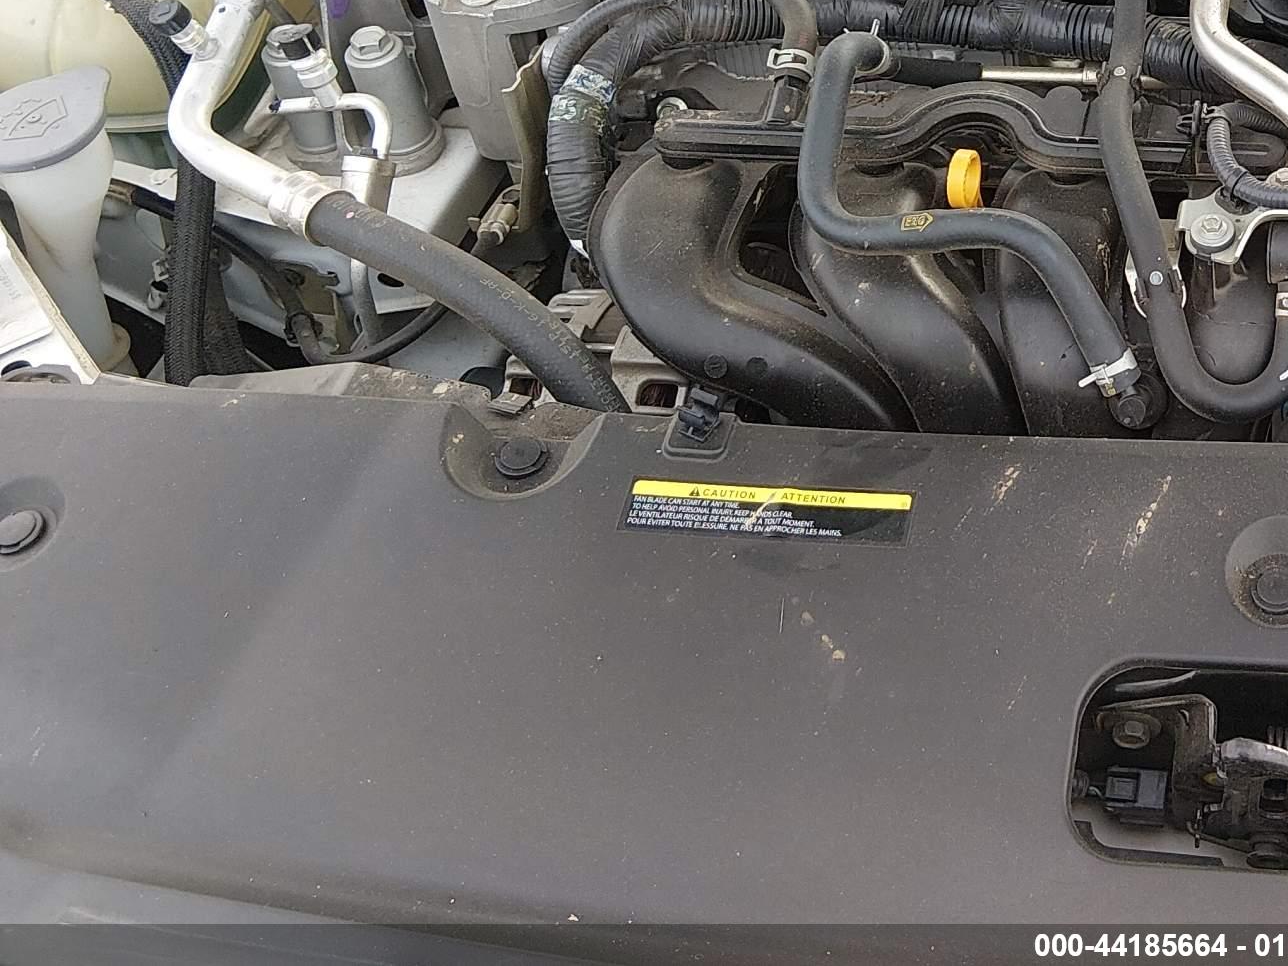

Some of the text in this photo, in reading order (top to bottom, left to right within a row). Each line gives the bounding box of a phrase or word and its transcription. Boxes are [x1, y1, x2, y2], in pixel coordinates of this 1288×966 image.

[703, 489, 846, 504] CAUTION ATTENTION
[638, 511, 683, 519] VENTILATEUR
[683, 514, 709, 522] RISQUE
[679, 506, 711, 514] PERSONAL
[671, 520, 693, 528] TOUTE
[740, 524, 753, 532] PAS
[765, 526, 805, 535] APPROCHER
